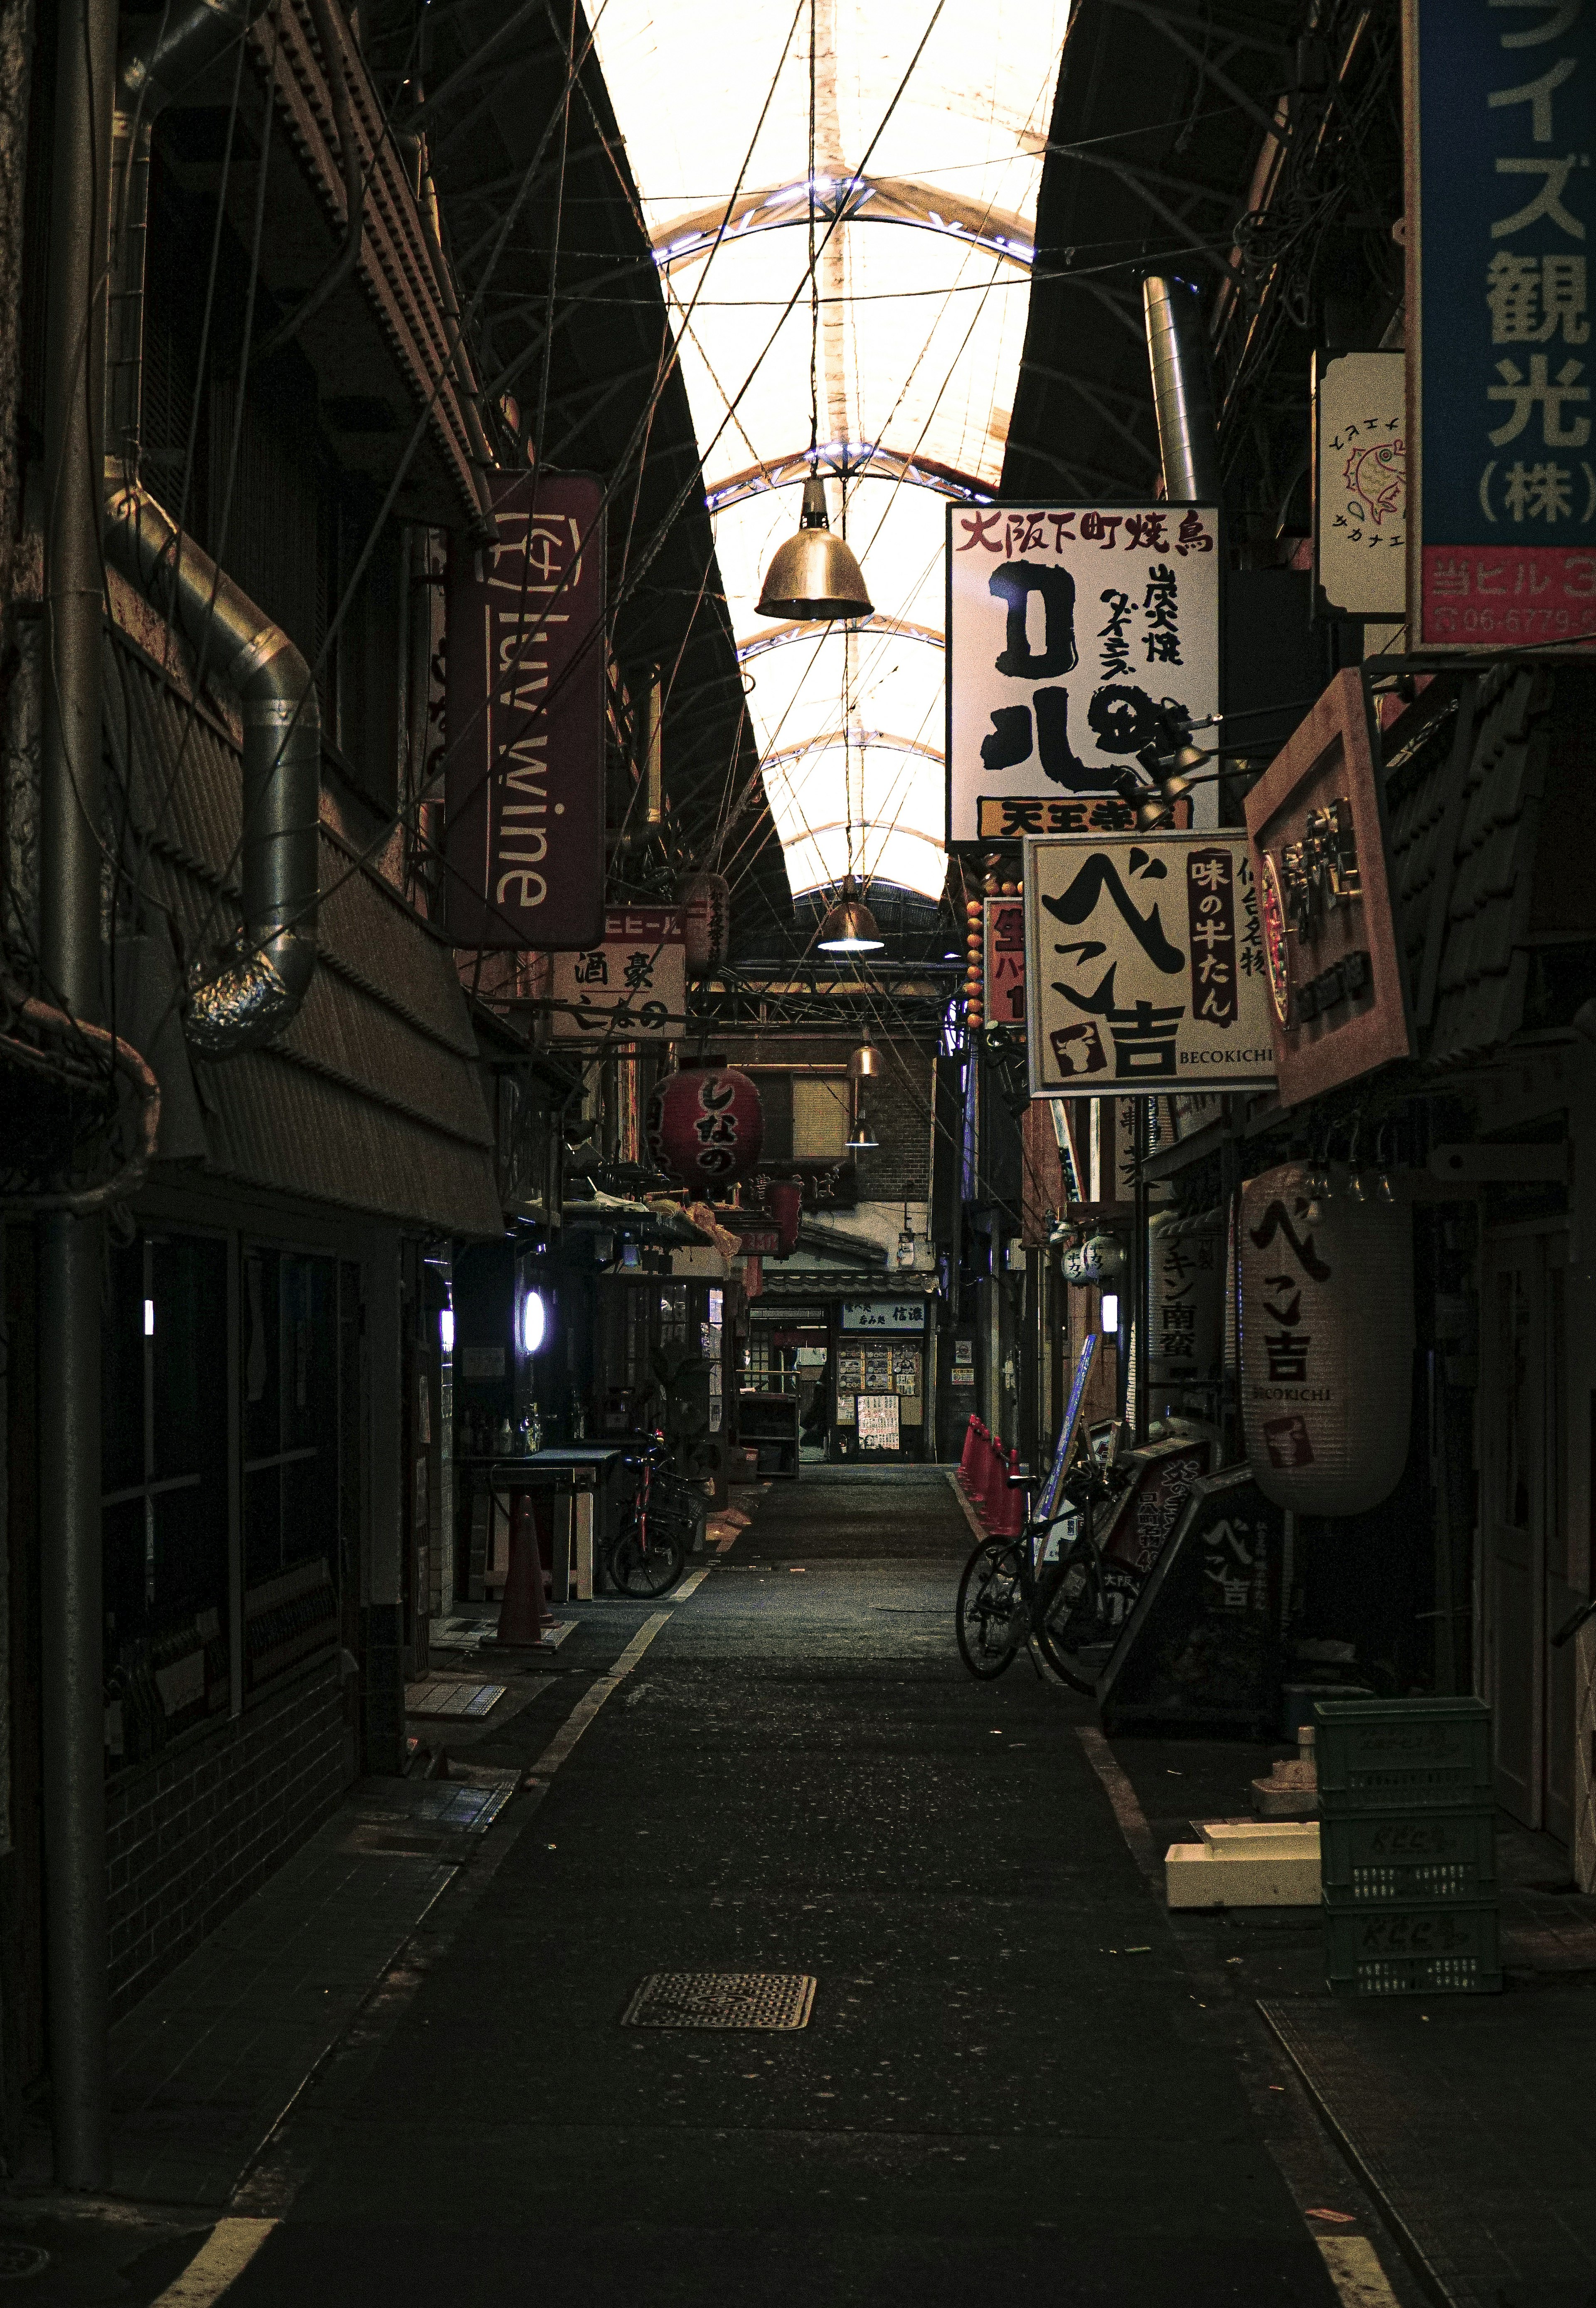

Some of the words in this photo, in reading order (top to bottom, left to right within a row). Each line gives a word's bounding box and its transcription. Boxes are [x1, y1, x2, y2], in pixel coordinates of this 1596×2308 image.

[956, 510, 1214, 558] 大阪下町焼鳥
[1142, 563, 1183, 665] 炭火焼
[500, 613, 569, 715] luv
[498, 735, 565, 907] wine
[1001, 801, 1175, 835] 天王寺
[575, 951, 653, 988] 酒豪
[1041, 847, 1186, 1078] べこ吉
[1192, 860, 1232, 1017] 味の牛たん
[1179, 1048, 1273, 1065] BECOKICHI
[694, 1077, 738, 1176] しなの
[893, 1307, 924, 1321] 信濃
[1249, 1197, 1332, 1382] べこ吉
[1201, 1517, 1254, 1606] べこ吉
